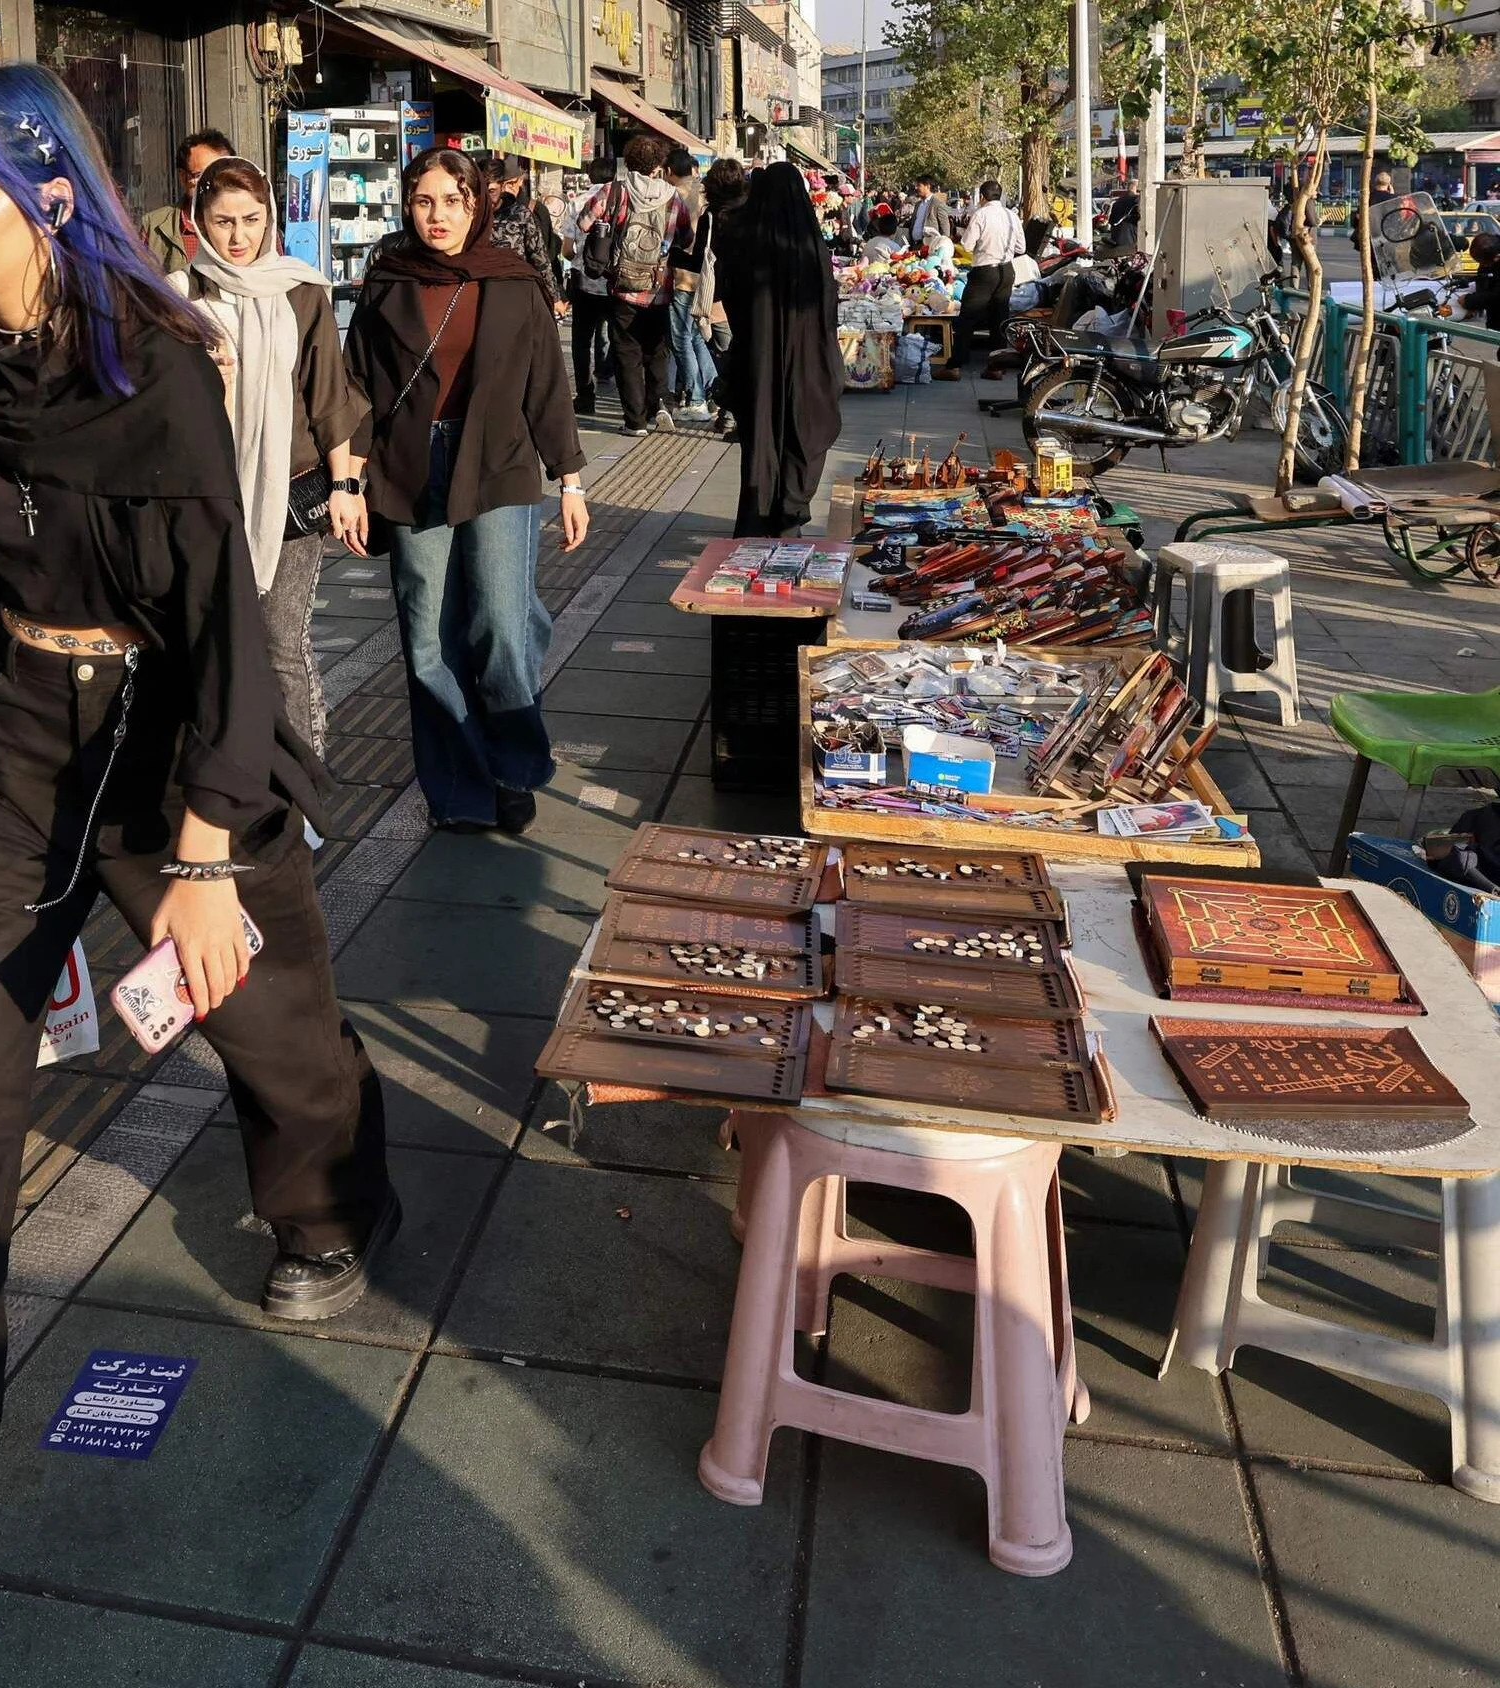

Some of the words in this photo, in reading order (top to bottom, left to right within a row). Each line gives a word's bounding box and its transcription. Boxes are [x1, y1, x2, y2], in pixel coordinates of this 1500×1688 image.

[288, 116, 328, 136] تعمیرات
[288, 141, 325, 161] فوری
[308, 501, 329, 520] CHA
[92, 1360, 146, 1377] شرکت
[150, 1364, 186, 1380] ثبت
[93, 1381, 125, 1393] رتبه
[128, 1383, 164, 1394] اخذ
[84, 1395, 118, 1405] رایگان
[114, 1414, 153, 1423] پرداخت
